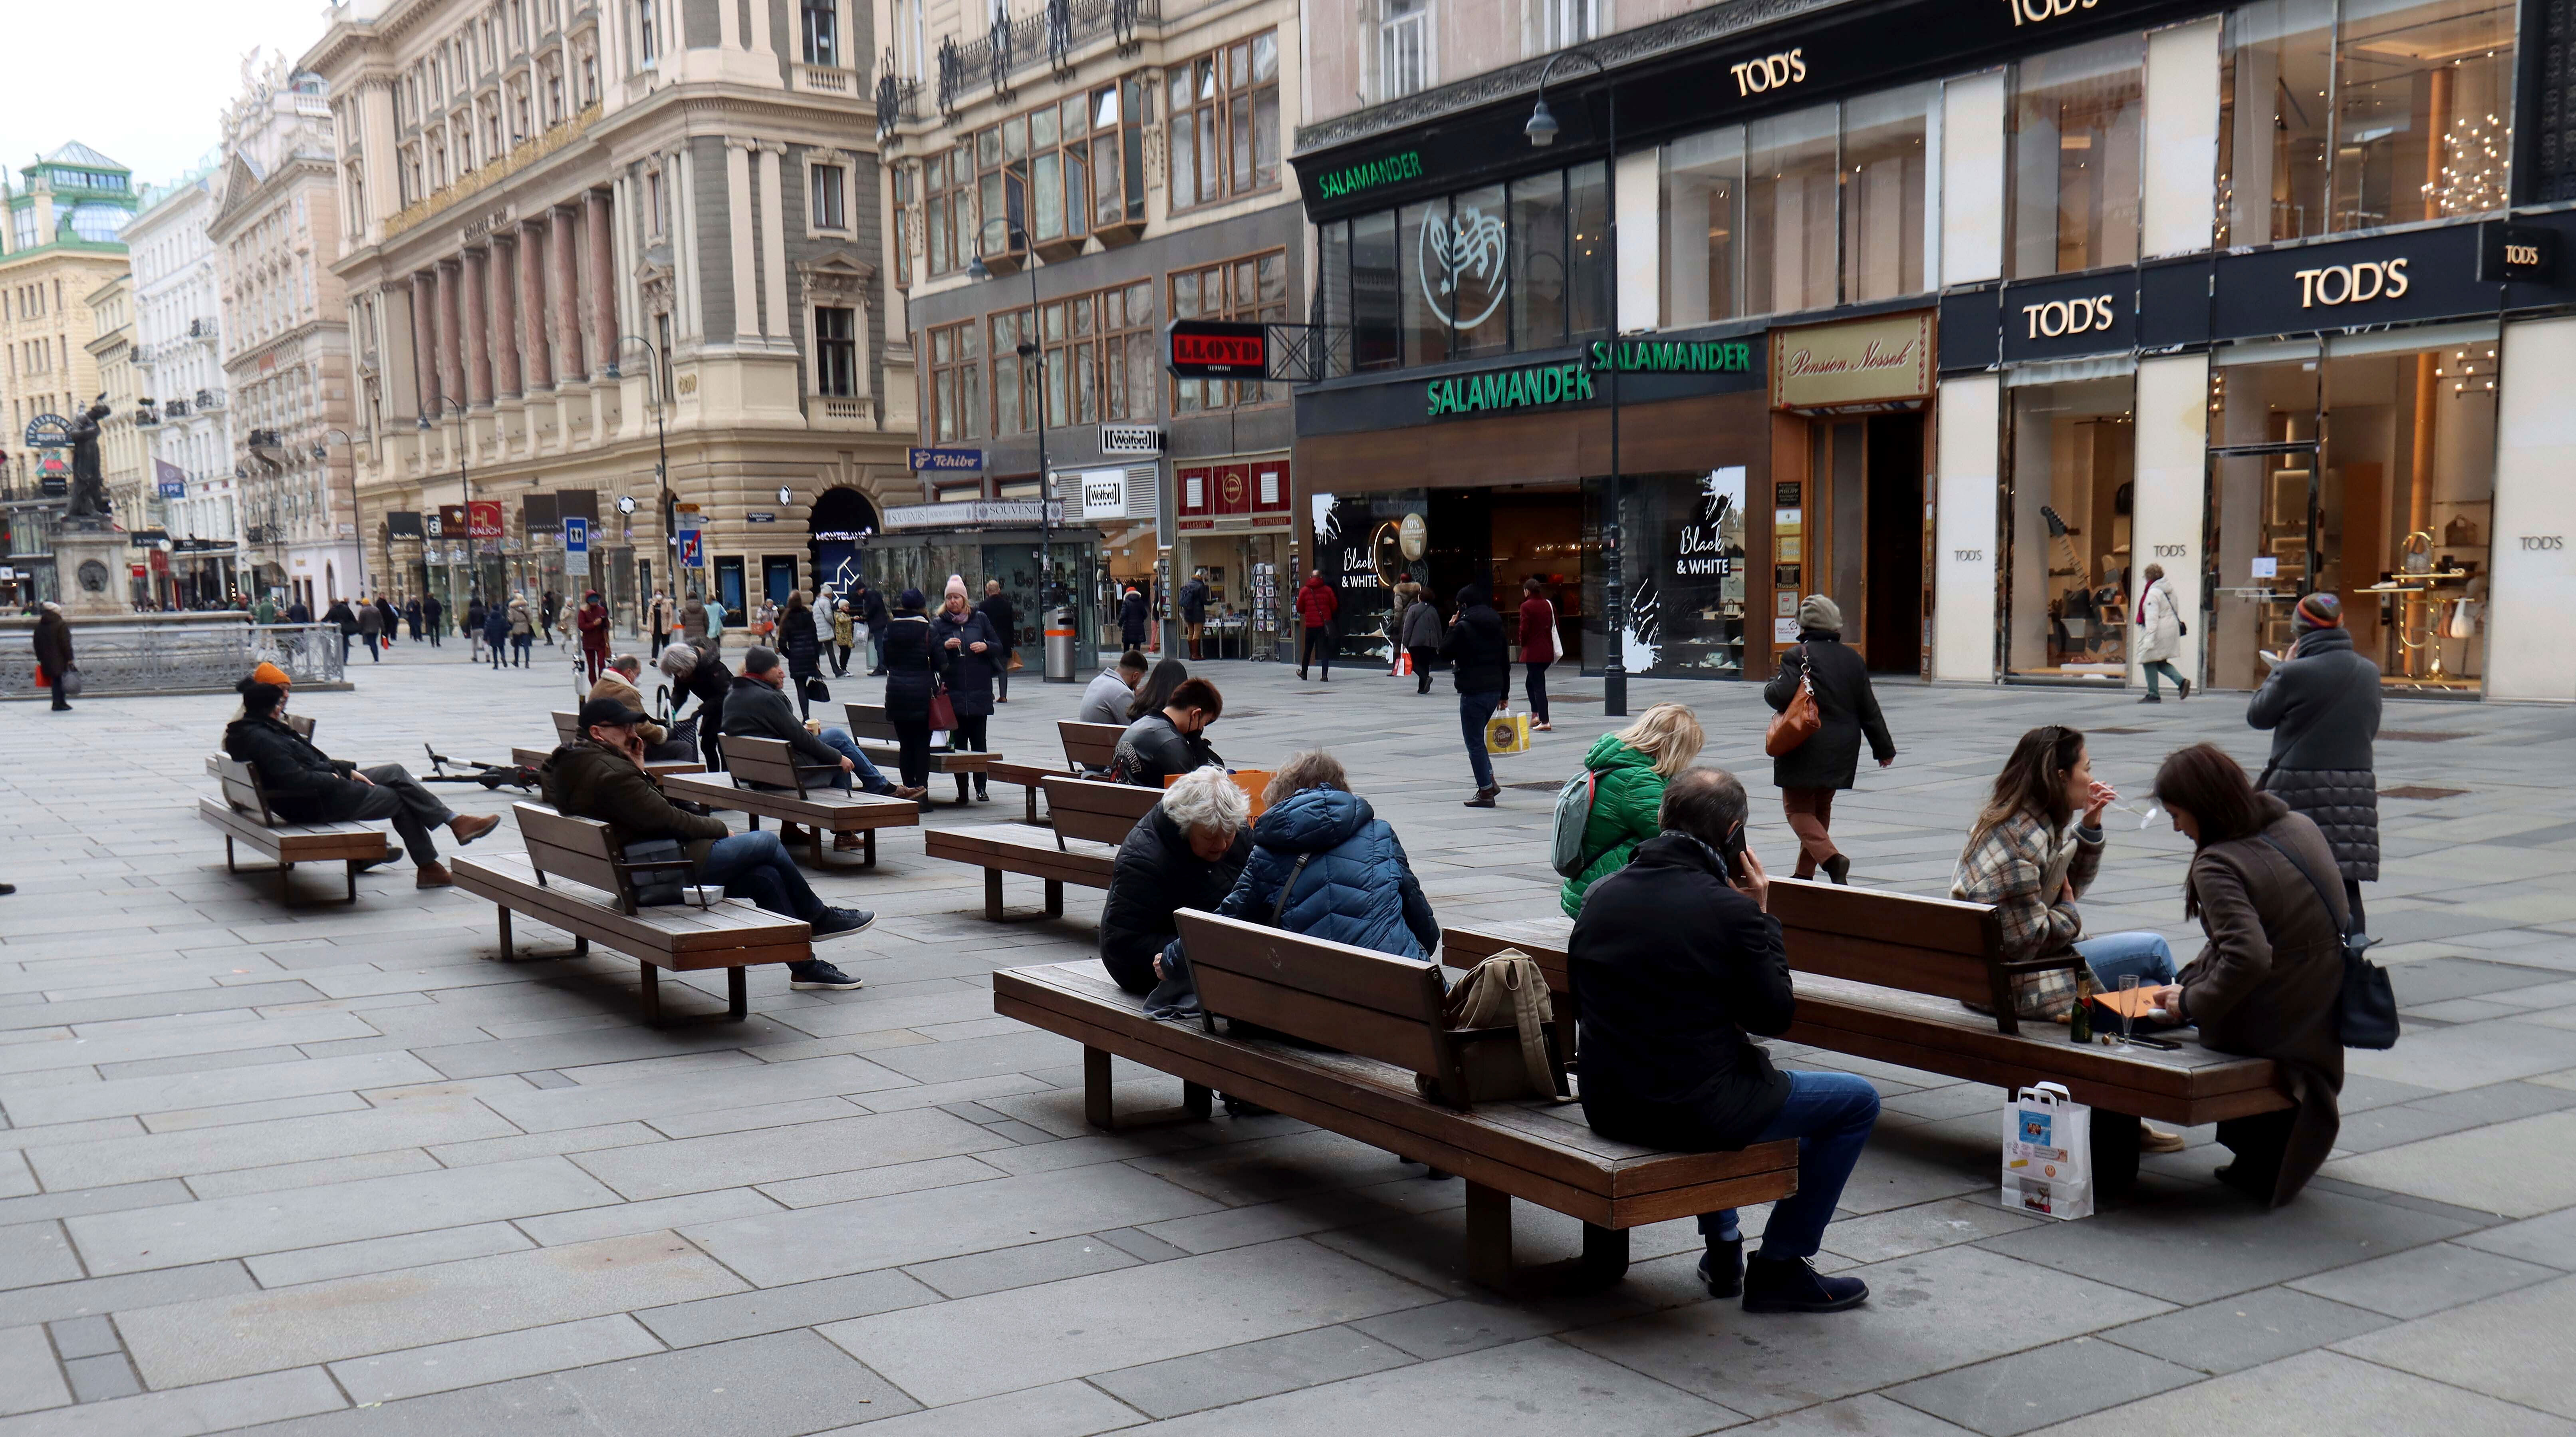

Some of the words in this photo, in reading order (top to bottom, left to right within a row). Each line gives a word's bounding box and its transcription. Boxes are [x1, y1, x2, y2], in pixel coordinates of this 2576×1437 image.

[2003, 0, 2097, 27] TOD
[1731, 48, 1807, 97] TOD'S
[1320, 151, 1423, 199] SALAMANDER
[2505, 244, 2539, 265] TOD'S
[2295, 258, 2409, 308] TOD'S
[2022, 294, 2113, 339] TOD'S
[1179, 339, 1259, 360] LLOYD
[1593, 341, 1749, 372] SALAMANDER
[1788, 349, 1848, 378] Pension
[1851, 337, 1915, 372] Nossek
[1427, 363, 1593, 415] SALAMANDER
[1113, 435, 1147, 445] Wolford
[933, 455, 978, 467] Tchibo
[1091, 488, 1114, 501] Wolford
[891, 509, 926, 523] SOUVENIRS
[1258, 518, 1287, 526] SPEZIALHAUS
[1407, 519, 1420, 529] 10%
[469, 527, 501, 535] RAUCH
[1679, 526, 1724, 555] Black
[2520, 536, 2564, 550] TOD'S
[1343, 547, 1374, 572] Black
[1954, 550, 1982, 561] TOD'S
[2154, 545, 2186, 557] TOD'S
[1677, 560, 1687, 574] &
[1689, 559, 1729, 574] WHITE
[1342, 576, 1349, 587] &
[1350, 575, 1377, 587] WHITE
